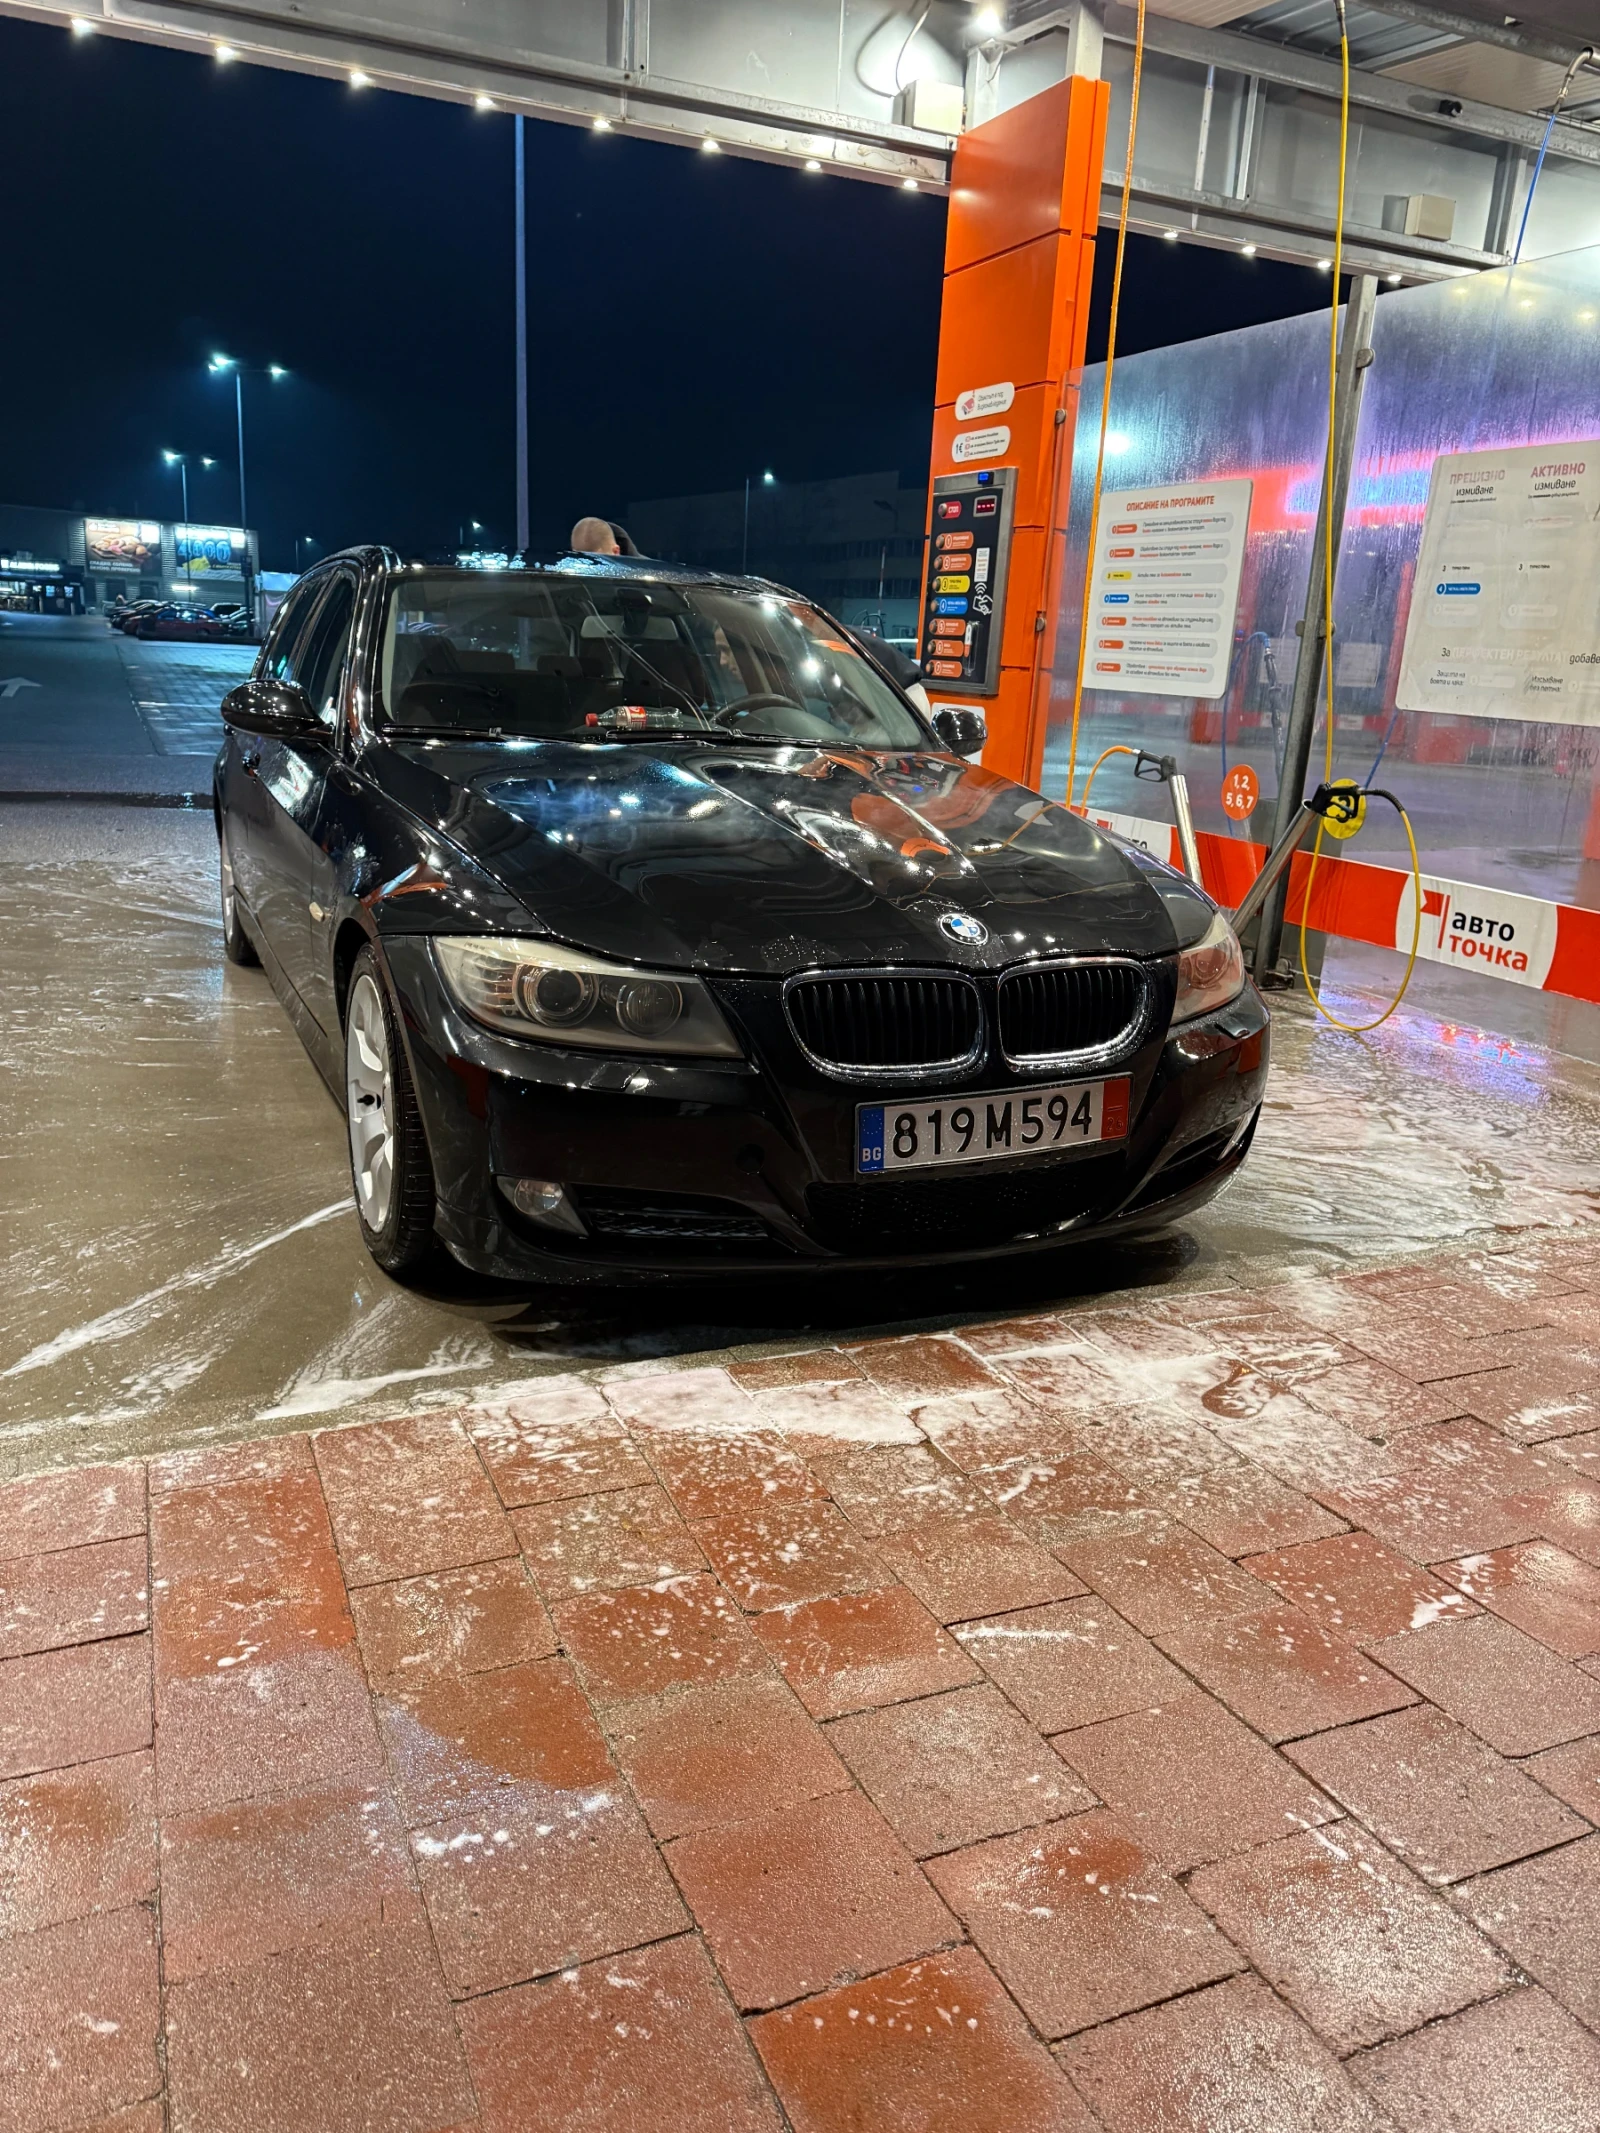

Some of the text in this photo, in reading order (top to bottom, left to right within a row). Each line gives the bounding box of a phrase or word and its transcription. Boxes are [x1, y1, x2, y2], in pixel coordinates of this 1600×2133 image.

[1450, 469, 1506, 486] ПРЕЦИЗНО
[1530, 462, 1586, 479] АКТИВНО
[1456, 485, 1494, 497] измиване
[1534, 479, 1577, 492] измиване
[1126, 495, 1215, 512] ОПИСАНИЕ НА ПРОГРАМИТЕ
[1441, 648, 1451, 657] За
[1452, 912, 1515, 942] авто
[1449, 935, 1529, 972] точка
[862, 1147, 882, 1162] BG
